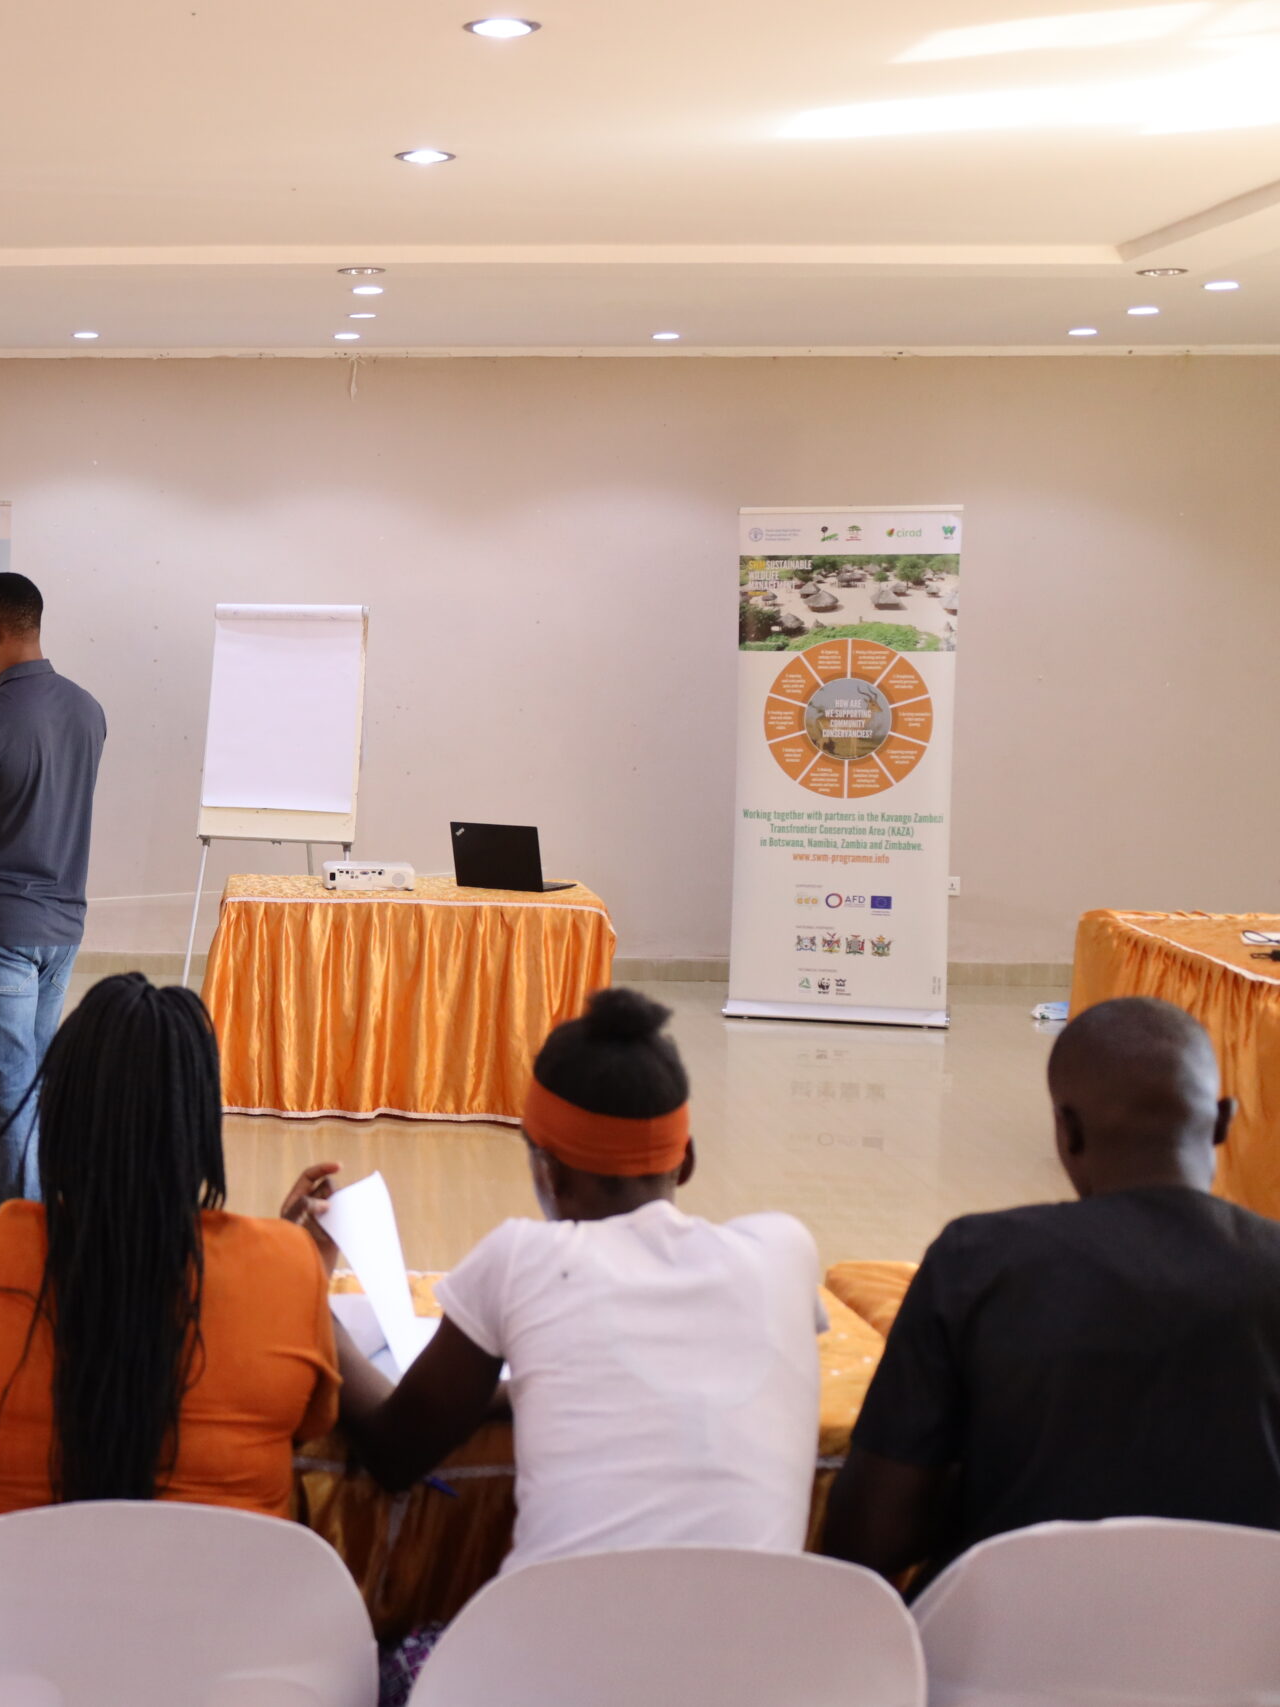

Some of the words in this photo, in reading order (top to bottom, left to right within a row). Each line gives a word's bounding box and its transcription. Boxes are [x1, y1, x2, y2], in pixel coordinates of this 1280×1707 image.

[896, 528, 922, 538] cirad
[766, 560, 812, 570] SUSTAINABLE
[834, 710, 871, 718] SUPPORTING
[830, 720, 864, 728] COMMUNITY
[743, 809, 772, 821] Working
[774, 810, 804, 822] together
[807, 810, 822, 820] with
[824, 812, 856, 822] partners
[858, 812, 864, 821] in
[866, 812, 878, 822] the
[881, 813, 912, 824] Kavango
[914, 813, 944, 823] Zambezi
[770, 824, 817, 834] Transfrontier
[820, 824, 867, 835] Conservation
[869, 826, 885, 836] Area
[888, 826, 914, 837] (KAZA)
[760, 837, 766, 846] in
[769, 837, 806, 848] Botswana,
[808, 838, 840, 849] Namibia,
[840, 839, 868, 849] Zambia
[870, 840, 882, 850] and
[884, 840, 924, 851] Zimbabwe.
[792, 854, 890, 864] www.swm-programme.info
[845, 896, 866, 904] AFD
